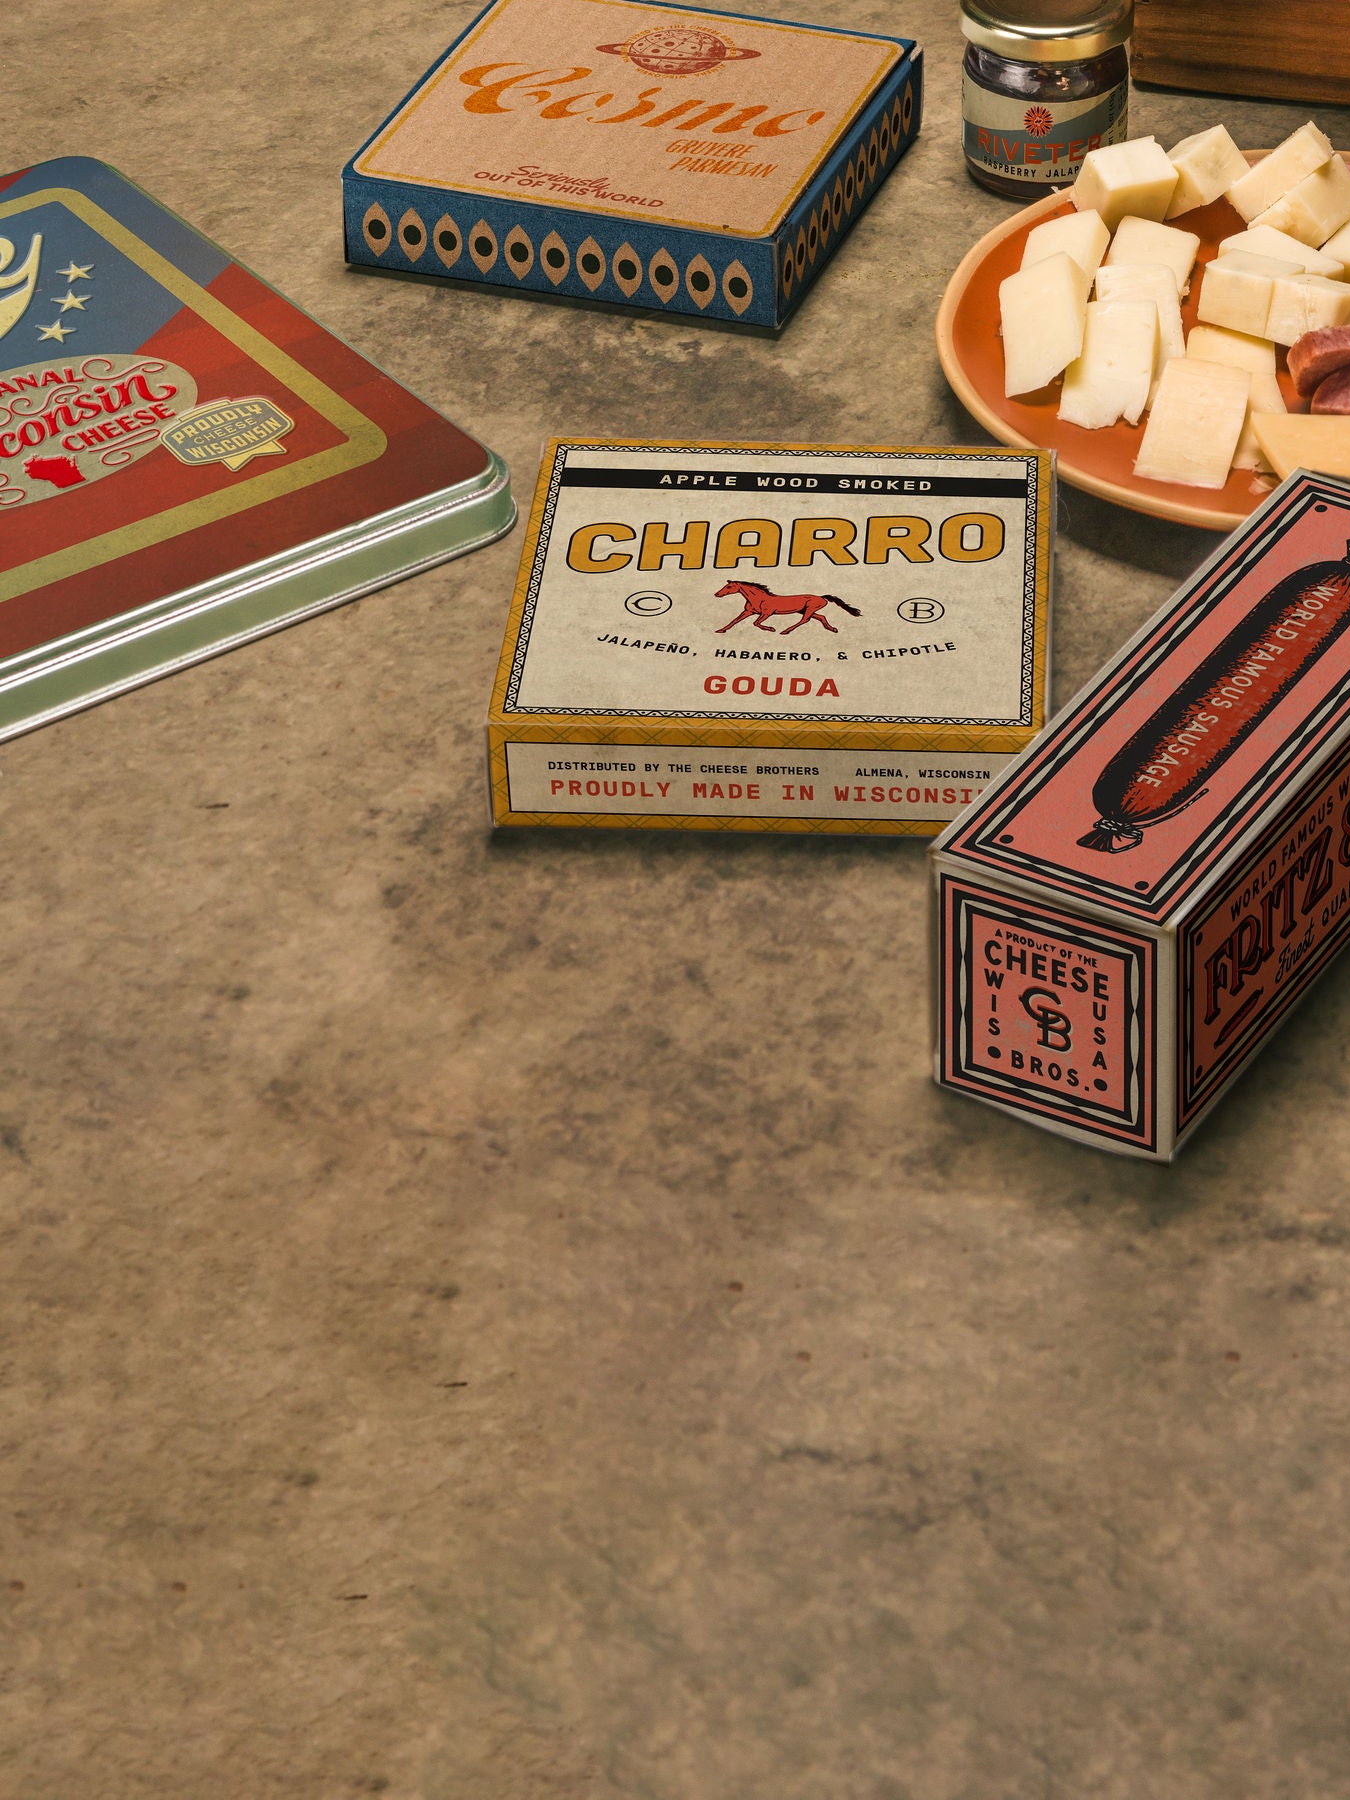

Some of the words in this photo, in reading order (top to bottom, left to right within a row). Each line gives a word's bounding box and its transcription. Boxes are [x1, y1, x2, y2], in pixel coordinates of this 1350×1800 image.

[459, 62, 826, 138] Cosmo
[665, 138, 757, 159] GRUYERE
[668, 156, 779, 179] PARMESAN
[978, 128, 1102, 165] RIVETER
[984, 156, 1037, 179] RASPBERRY
[1046, 164, 1083, 179] JALAP
[474, 170, 513, 184] OUT
[517, 178, 543, 189] OF
[550, 183, 591, 196] THIS
[594, 189, 664, 208] WORLD
[511, 165, 611, 194] Seriously
[0, 373, 178, 459] consin
[61, 402, 176, 452] CHEESE
[171, 403, 263, 446] PROUDLY
[193, 416, 258, 445] CHEESE
[184, 416, 282, 460] WISCONSIN
[659, 473, 738, 487] APPLE
[755, 476, 820, 490] WOOD
[838, 478, 934, 492] SMOKED
[565, 511, 1007, 575] CHARRO
[1275, 584, 1340, 642] WORLD
[596, 633, 699, 658] JALAPEÑO,
[714, 648, 822, 663] HABANERO,
[838, 651, 849, 661] &
[861, 641, 957, 660] CHIPOTLE
[703, 674, 841, 698] GOUDA
[1210, 641, 1285, 711] FAMOUS
[548, 760, 636, 772] DISTRIBUTED
[644, 763, 660, 772] BY
[668, 763, 692, 773] THE
[699, 764, 748, 775] CHEESE
[755, 765, 820, 777] BROTHERS
[855, 767, 911, 780] ALMENA,
[918, 768, 991, 780] WISCONSIN
[1136, 710, 1220, 790] SAUSAGE
[550, 779, 672, 799] PROUDLY
[692, 782, 761, 800] MADE
[781, 784, 814, 801] IN
[834, 785, 984, 804] WISCONSI
[1229, 862, 1276, 923] WORLD
[1281, 799, 1335, 867] FAMOUS
[1204, 825, 1335, 1026] FRITZ
[995, 928, 1003, 938] A
[1060, 947, 1073, 960] OF
[1077, 953, 1099, 969] THE
[1274, 921, 1317, 985] Finest
[984, 939, 1110, 1003] CHEESE
[1010, 1049, 1091, 1092] BROS.
